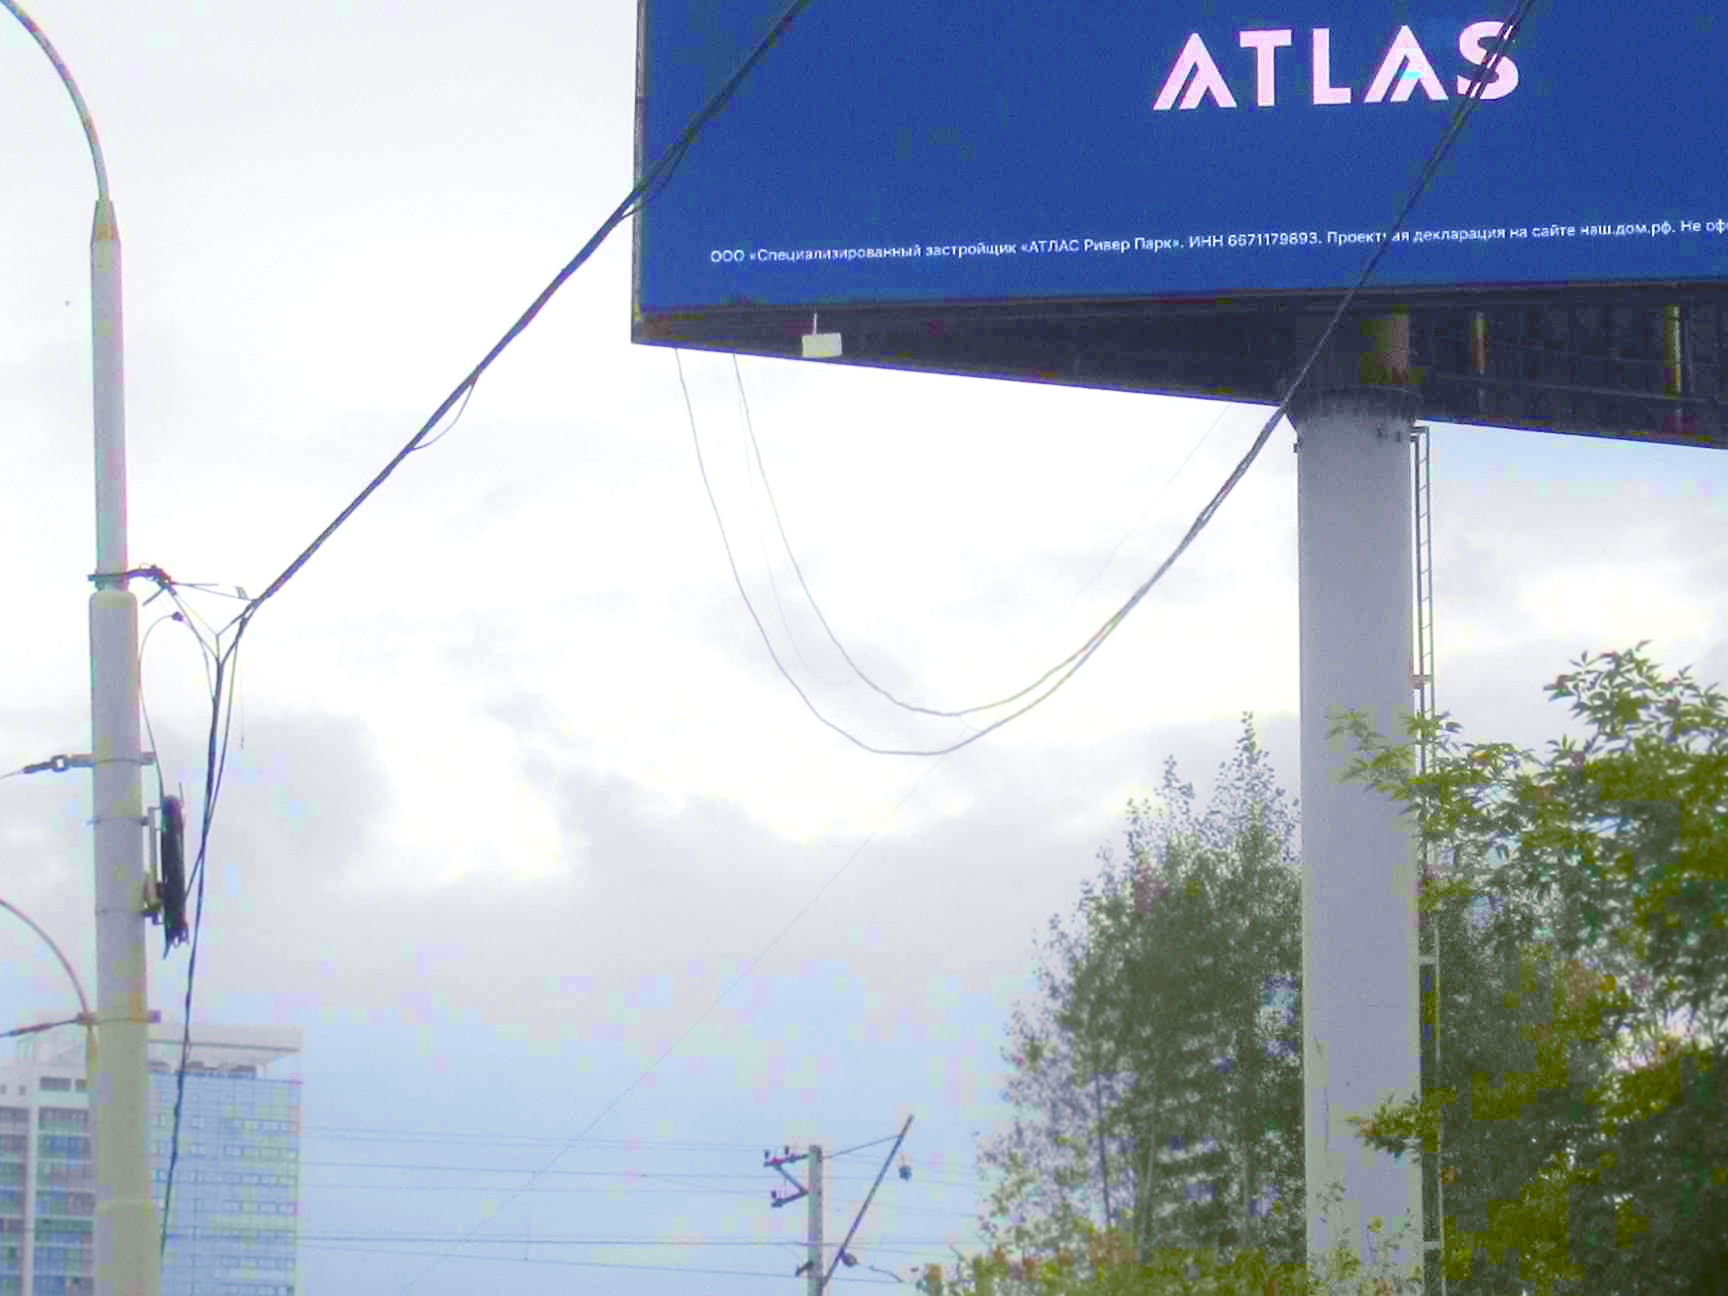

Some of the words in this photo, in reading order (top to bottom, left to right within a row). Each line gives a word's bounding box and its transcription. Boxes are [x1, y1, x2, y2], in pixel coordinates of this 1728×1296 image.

[1153, 19, 1521, 112] ATLAS
[710, 249, 745, 263] ООО
[749, 244, 922, 264] «Специализированный
[925, 241, 1017, 260] застройщик
[1021, 238, 1080, 254] «АТЛАС
[1083, 237, 1129, 255] Ривер
[1188, 234, 1224, 249] ИНН
[1413, 225, 1506, 244] декларация
[1510, 227, 1528, 239] на
[1532, 222, 1576, 239] сайте
[1580, 219, 1677, 238] наш.дом.рф.
[1680, 219, 1702, 233] Не
